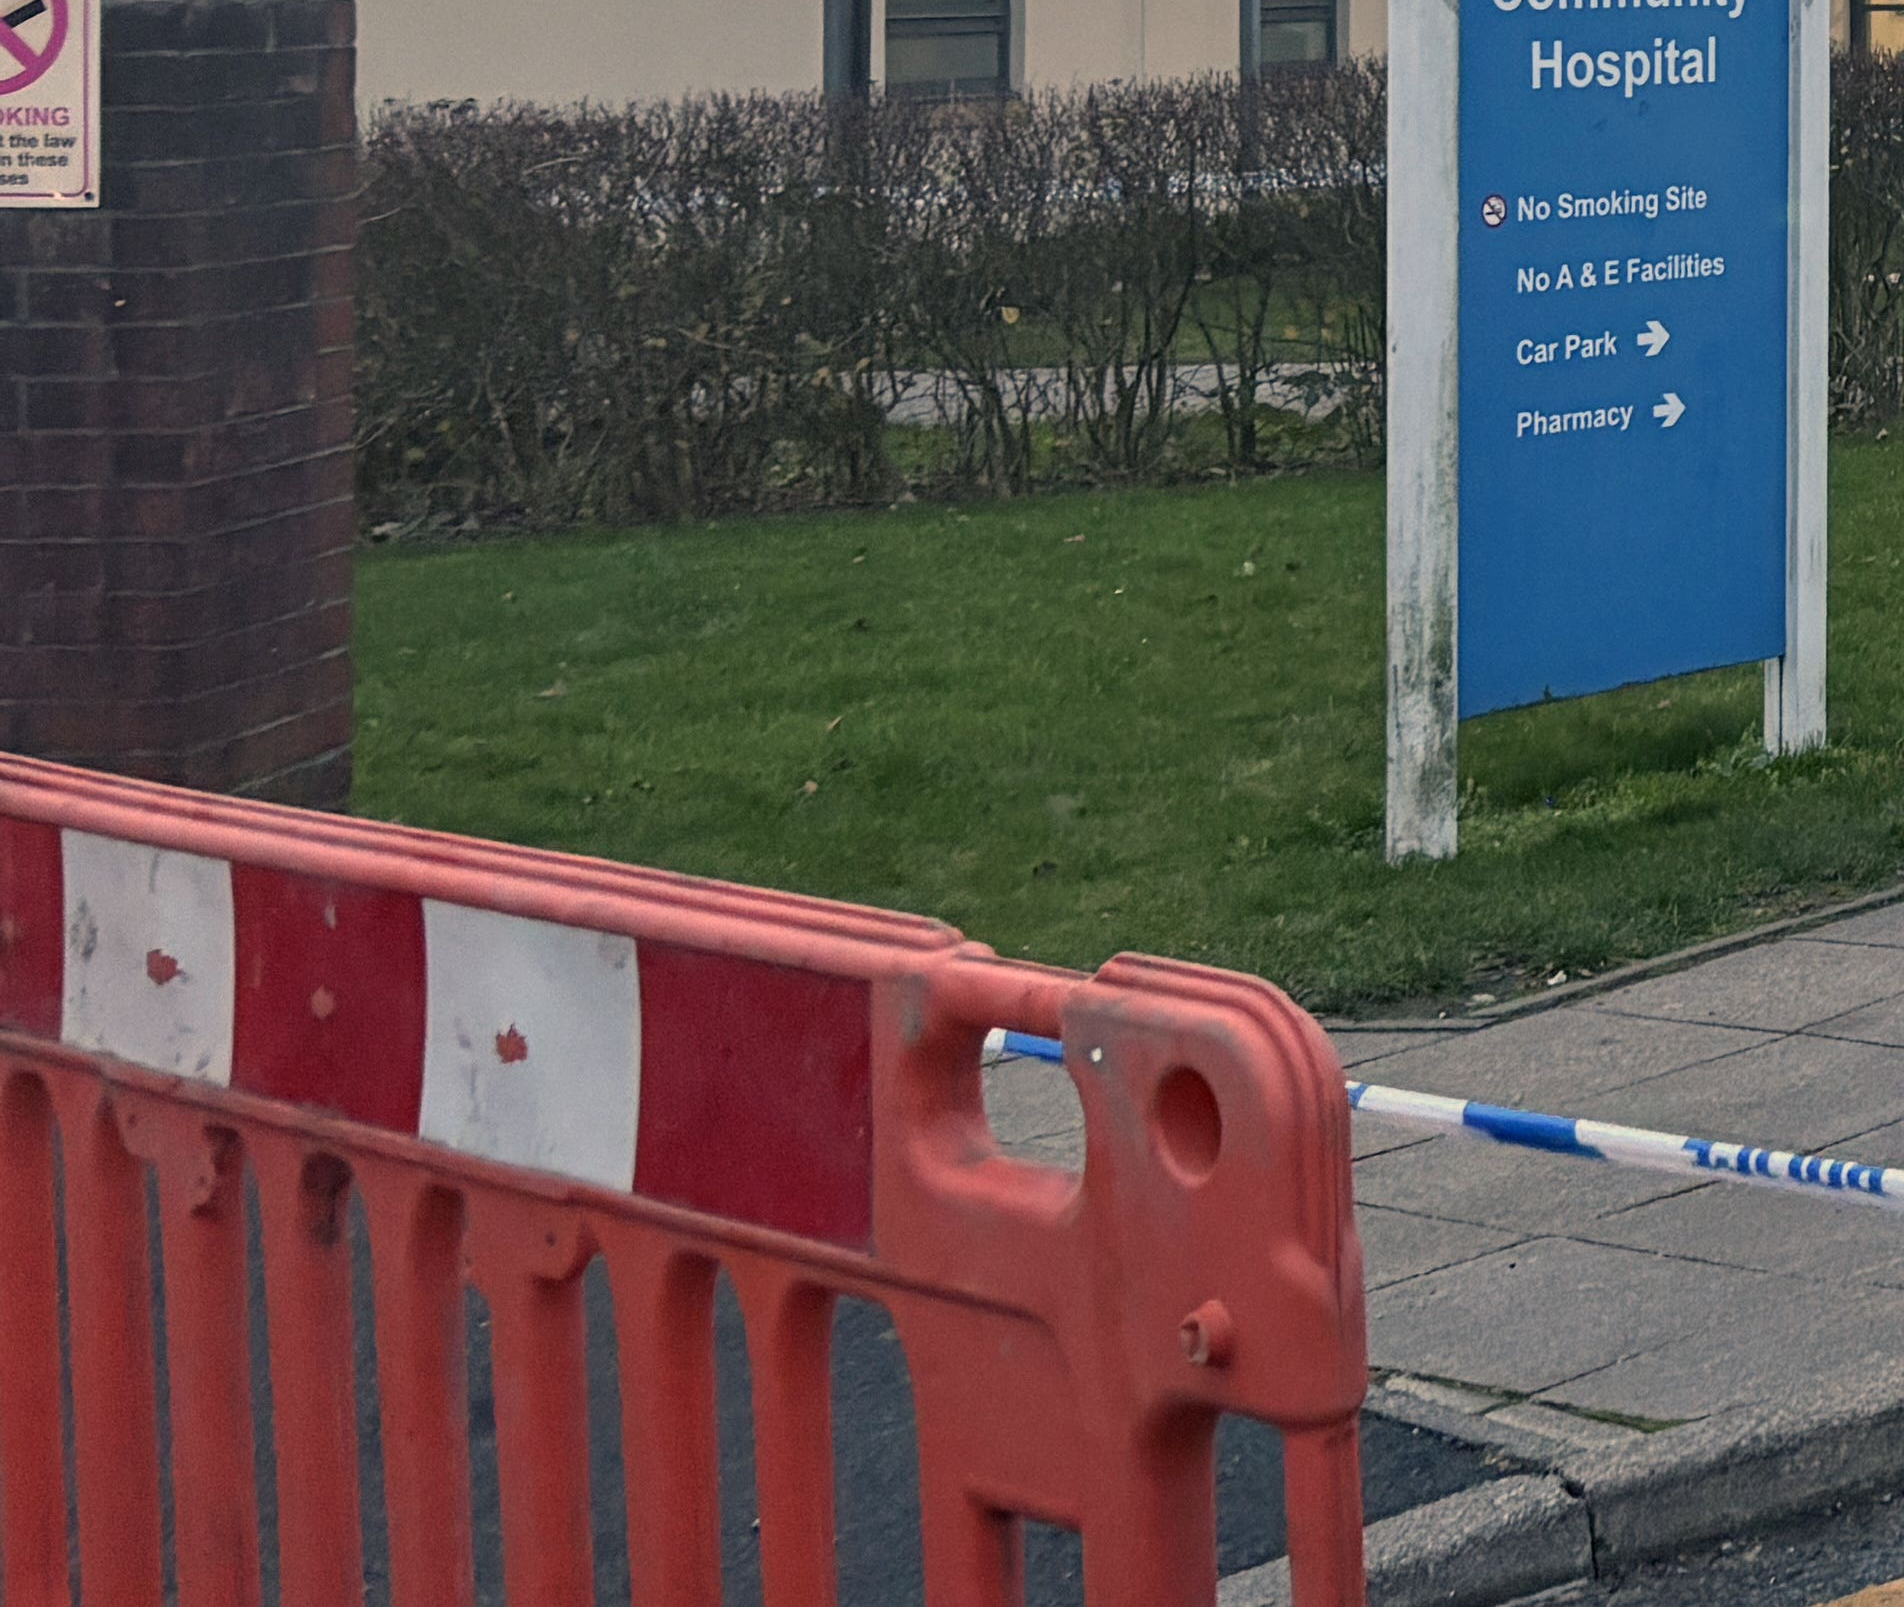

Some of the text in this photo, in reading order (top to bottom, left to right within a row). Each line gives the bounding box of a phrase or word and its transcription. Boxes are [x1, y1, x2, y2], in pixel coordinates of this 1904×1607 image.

[1531, 37, 1716, 98] Hospital
[9, 134, 39, 148] the
[45, 134, 76, 148] law
[17, 152, 69, 168] these
[1518, 186, 1707, 221] No Smoking Site
[1518, 253, 1725, 292] No A & E Facilities
[1517, 331, 1617, 365] Car Park
[1517, 406, 1633, 438] Pharmacy
